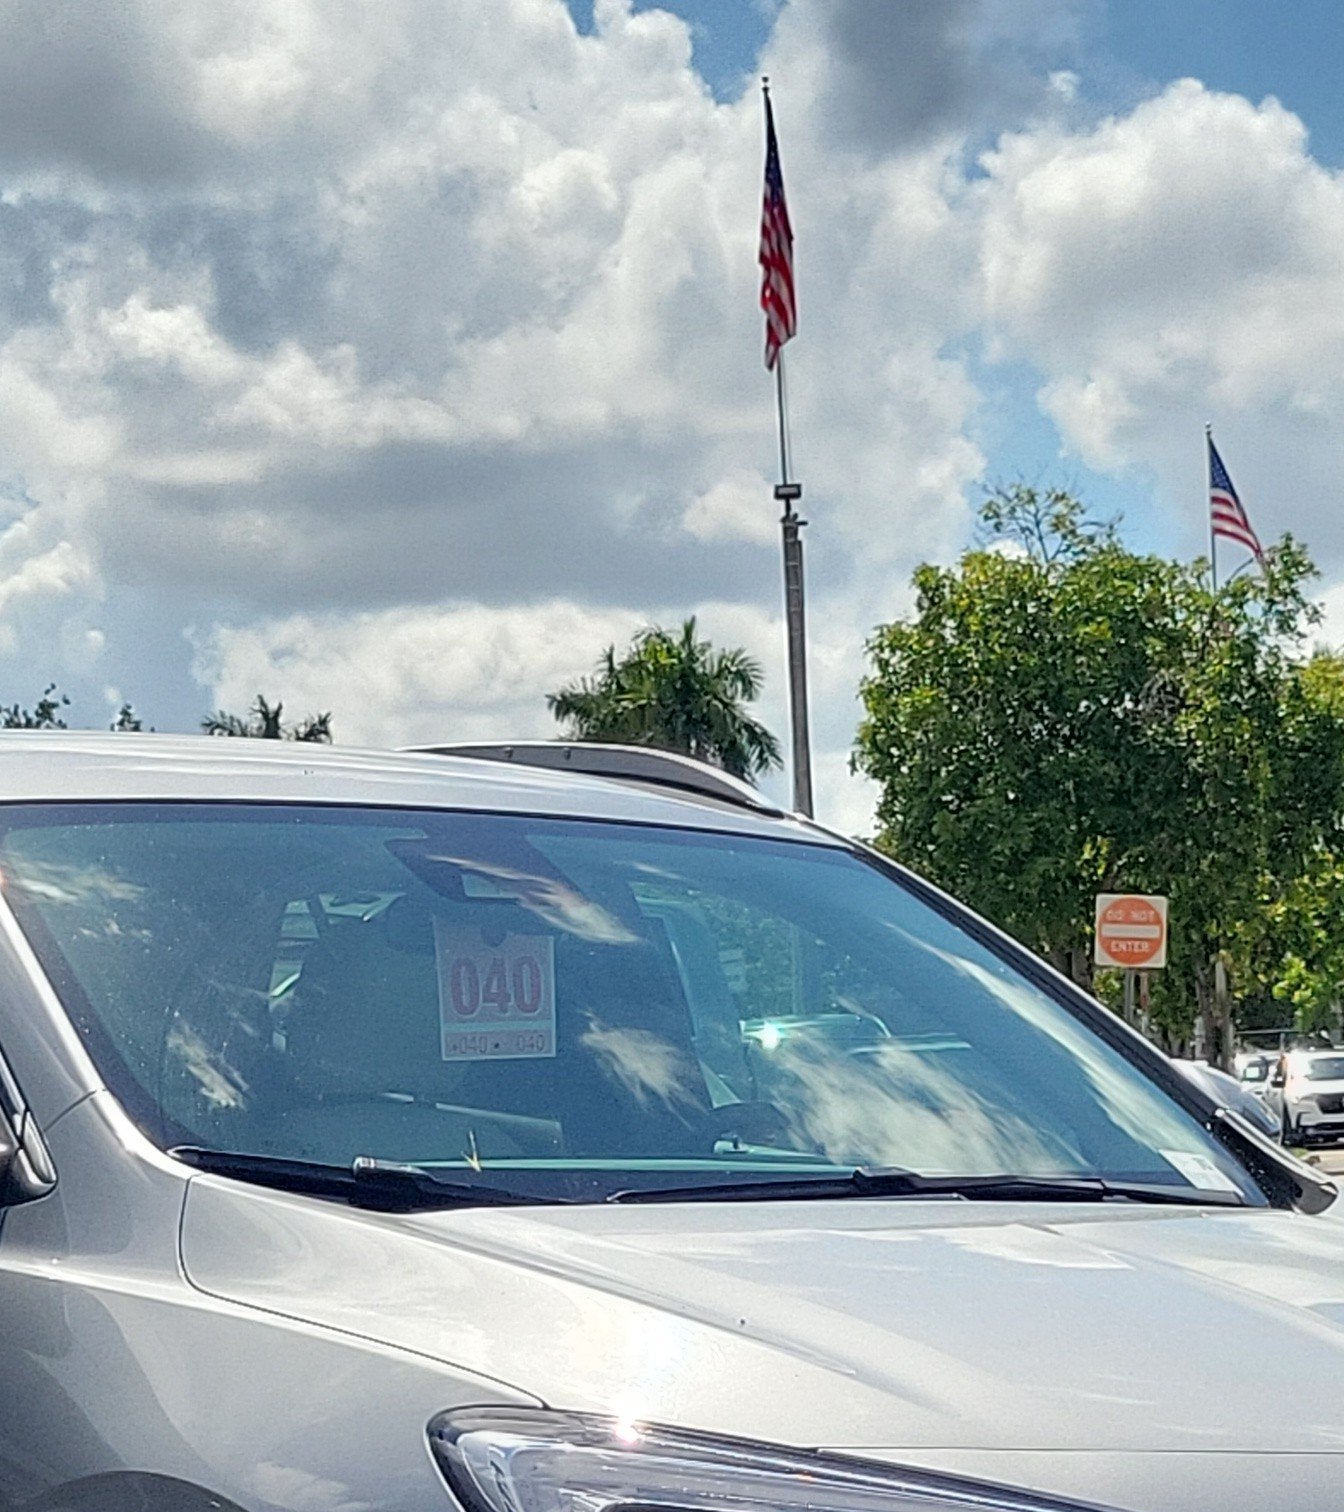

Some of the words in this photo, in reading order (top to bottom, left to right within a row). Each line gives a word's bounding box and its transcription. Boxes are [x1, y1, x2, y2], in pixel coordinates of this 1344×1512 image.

[1106, 909, 1123, 921] DO
[1130, 910, 1155, 922] NOT
[1110, 940, 1148, 953] ENTER
[451, 955, 542, 1016] 040
